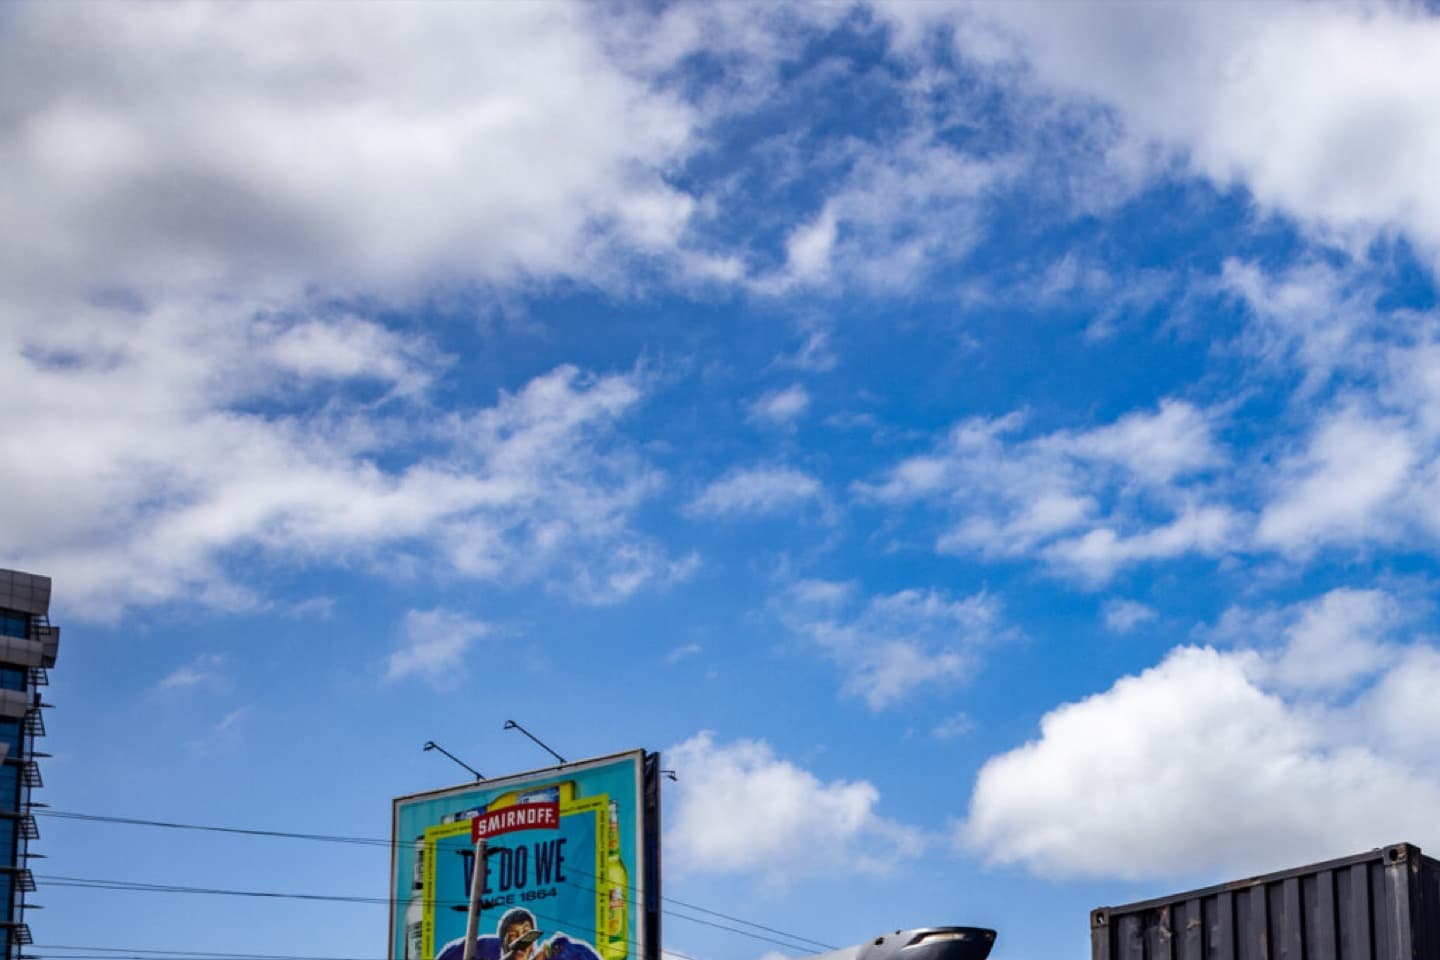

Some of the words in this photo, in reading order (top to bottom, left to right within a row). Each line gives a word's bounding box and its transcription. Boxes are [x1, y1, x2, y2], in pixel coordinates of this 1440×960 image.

[478, 808, 554, 835] SMIRNOFF
[500, 845, 528, 891] DO
[535, 838, 567, 886] WE
[521, 888, 557, 902] 1864
